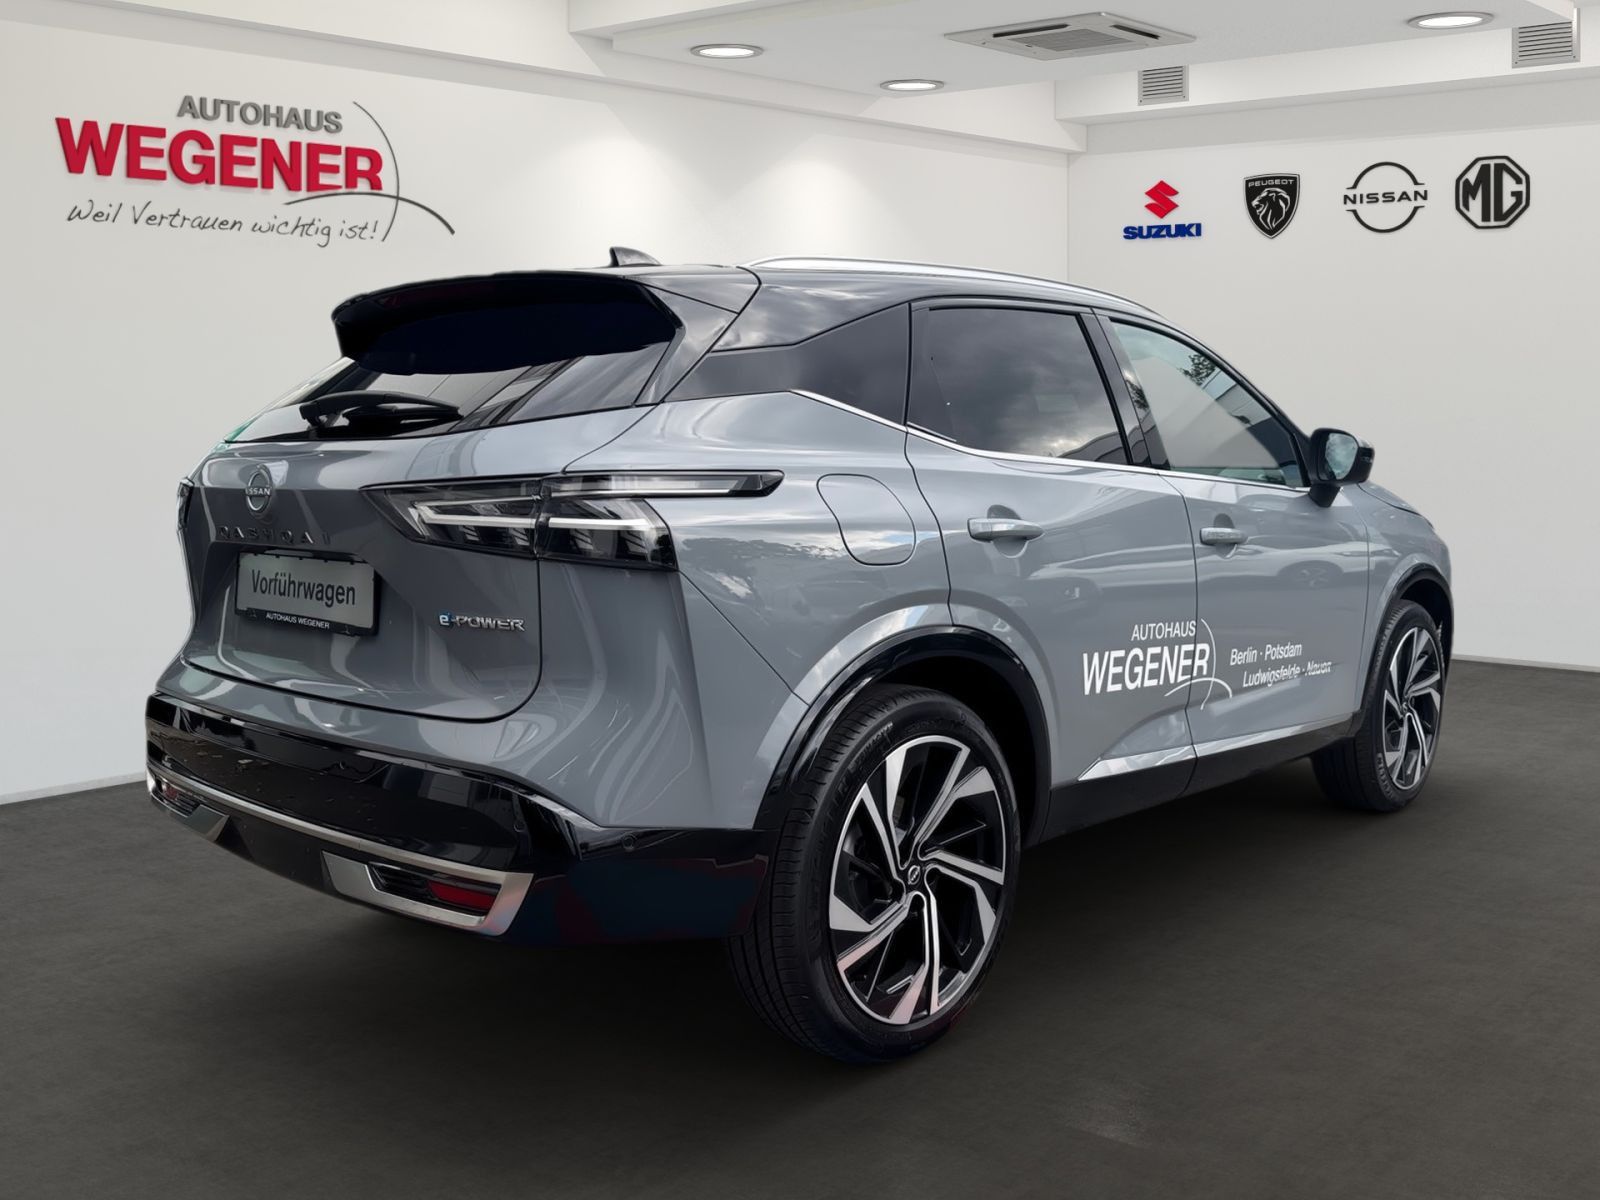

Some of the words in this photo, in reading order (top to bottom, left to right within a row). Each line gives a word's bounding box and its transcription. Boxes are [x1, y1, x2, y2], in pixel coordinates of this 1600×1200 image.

[177, 95, 343, 133] AUTOHAUS
[55, 117, 384, 192] WEGENER
[1248, 178, 1295, 188] PEUGEOT
[1462, 162, 1523, 223] MG
[1343, 189, 1428, 205] NISSAN
[67, 199, 123, 223] Weil
[132, 201, 243, 232] Vertrauen
[251, 215, 332, 248] wichtig
[339, 221, 377, 241] ist!
[1123, 223, 1202, 240] SUZUKI
[252, 569, 356, 608] Vorführwagen
[265, 612, 297, 624] AUTOHAUS
[297, 617, 330, 630] WEGENER
[439, 613, 525, 631] e-POWER
[1131, 620, 1196, 641] AUTOHAUS
[1230, 647, 1258, 666] Berlin
[1264, 642, 1302, 661] Potsdam
[1082, 643, 1210, 696] WEGENER
[1242, 663, 1301, 687] Ludwigsfelde
